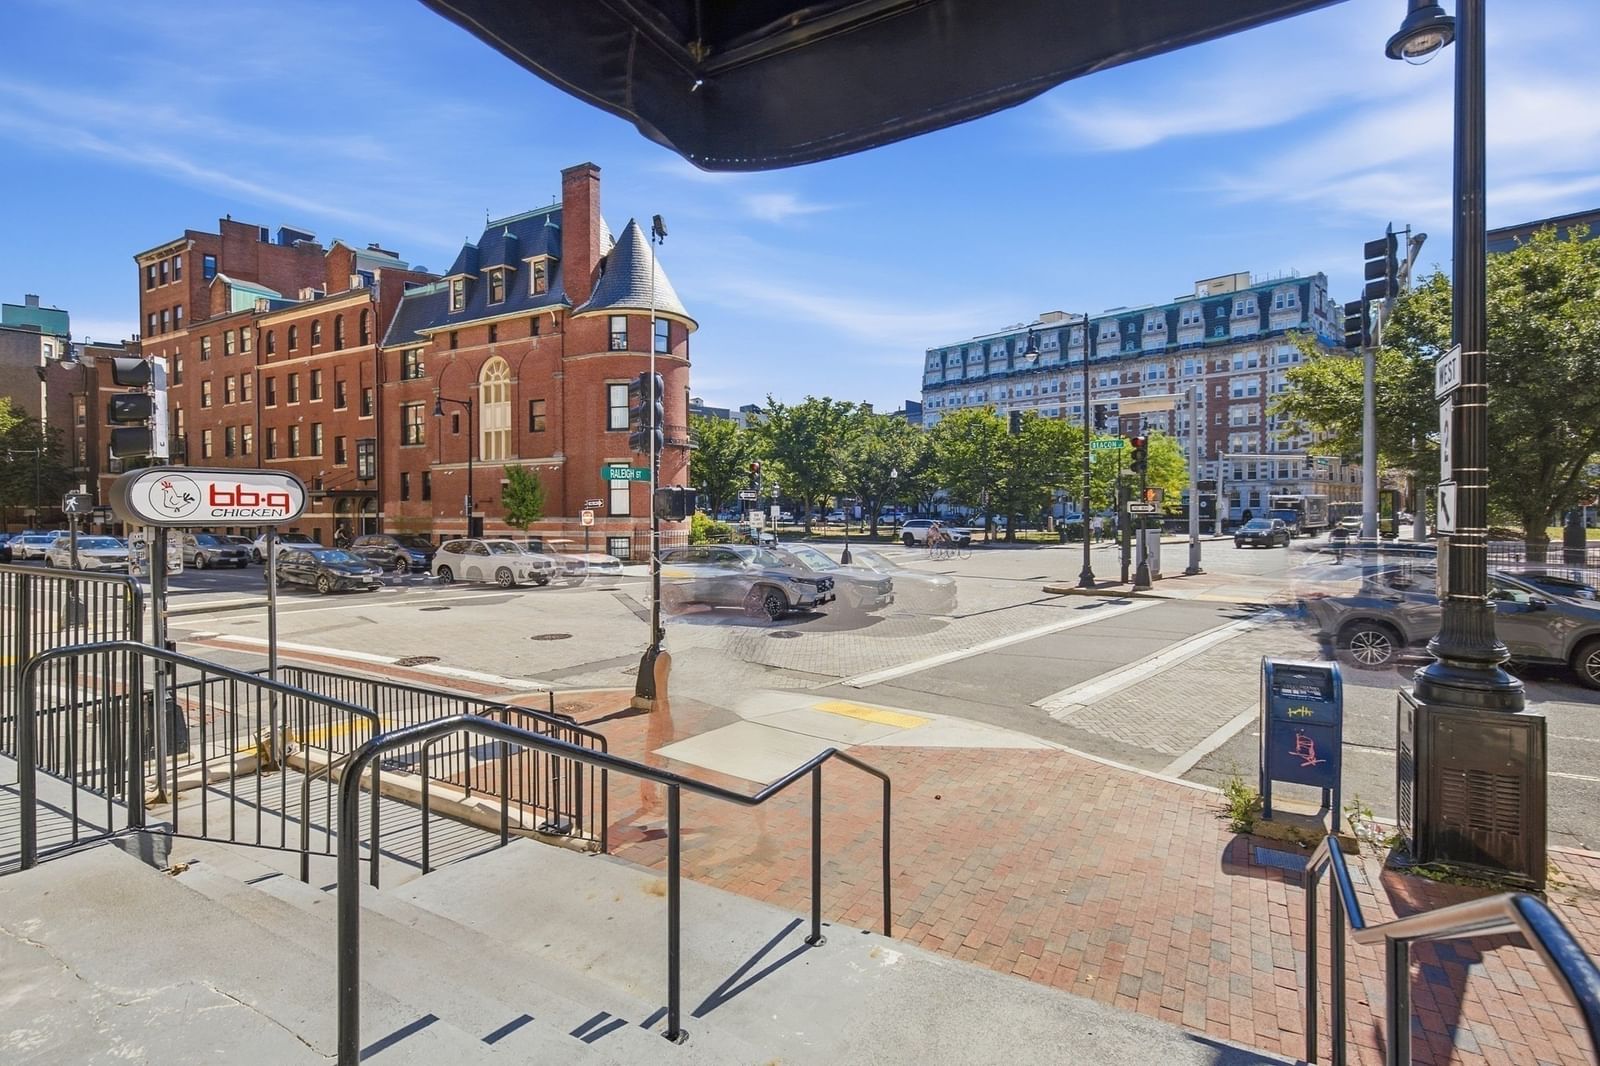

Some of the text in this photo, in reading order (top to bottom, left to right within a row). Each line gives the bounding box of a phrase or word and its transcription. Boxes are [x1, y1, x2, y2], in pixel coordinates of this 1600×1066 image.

[1438, 357, 1456, 386] WEST
[1093, 441, 1117, 449] BEACON
[1443, 420, 1449, 462] 2
[610, 468, 634, 479] RALEIGH
[211, 508, 282, 517] CHICKEN
